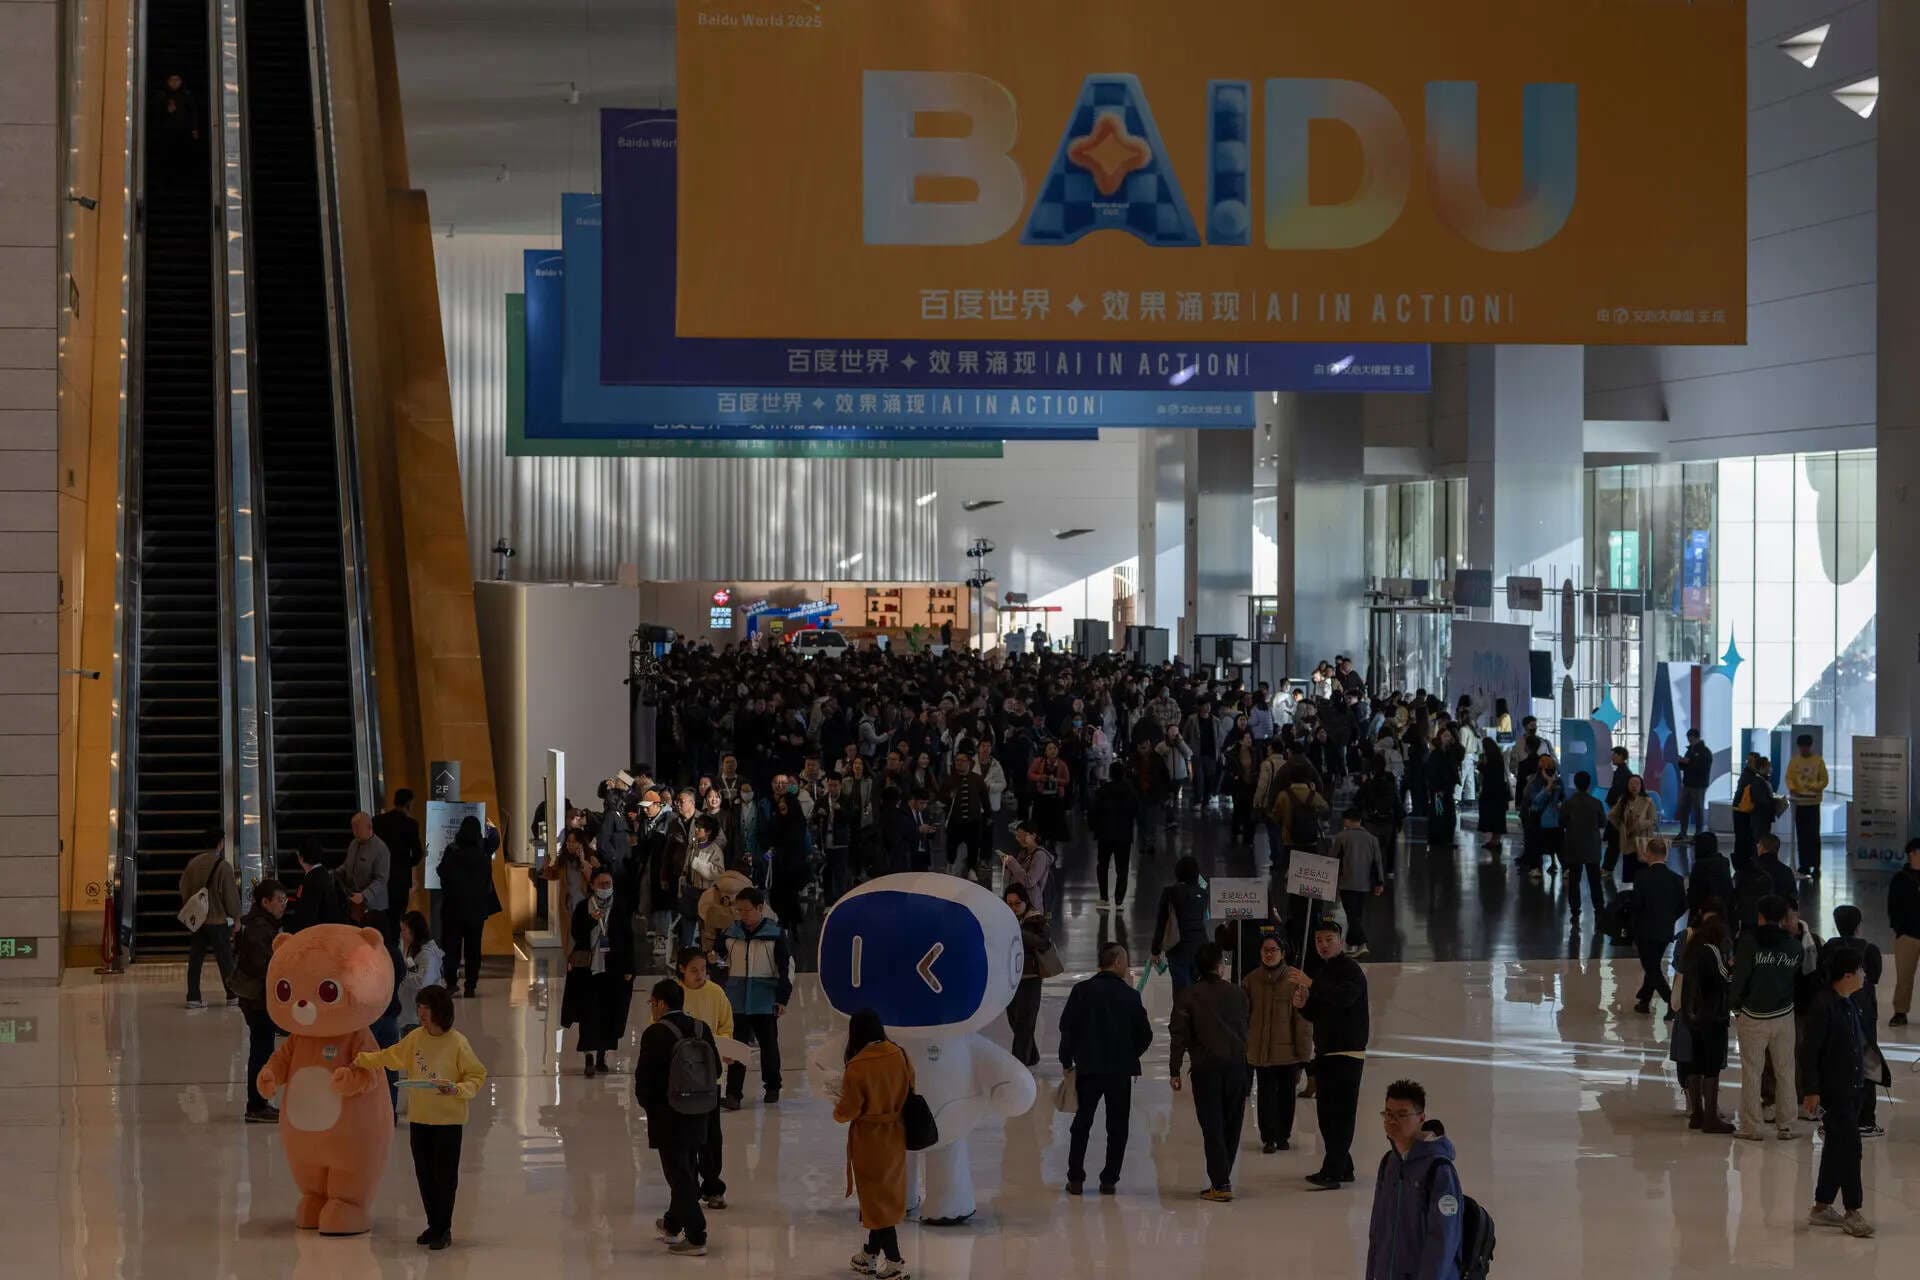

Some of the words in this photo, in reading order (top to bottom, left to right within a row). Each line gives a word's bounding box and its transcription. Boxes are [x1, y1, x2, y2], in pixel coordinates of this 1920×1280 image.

[697, 13, 738, 25] Baidu
[742, 13, 783, 26] World
[787, 15, 823, 28] 2025
[862, 69, 1578, 253] BAIDU
[919, 289, 1050, 320] 百度世界
[1101, 290, 1240, 321] 效果涌现
[1266, 292, 1299, 321] AI
[1319, 293, 1351, 321] IN
[1372, 294, 1500, 323] ACTION
[787, 349, 889, 374] 百度世界
[929, 350, 1037, 375] 效果涌现
[1056, 352, 1081, 375] AI
[1097, 352, 1123, 375] IN
[1138, 353, 1239, 376] ACTION
[717, 392, 803, 413] 百度世界
[835, 393, 925, 414] 效果涌现
[942, 394, 962, 414] AI
[976, 395, 997, 415] IN
[1010, 395, 1094, 415] ACTION
